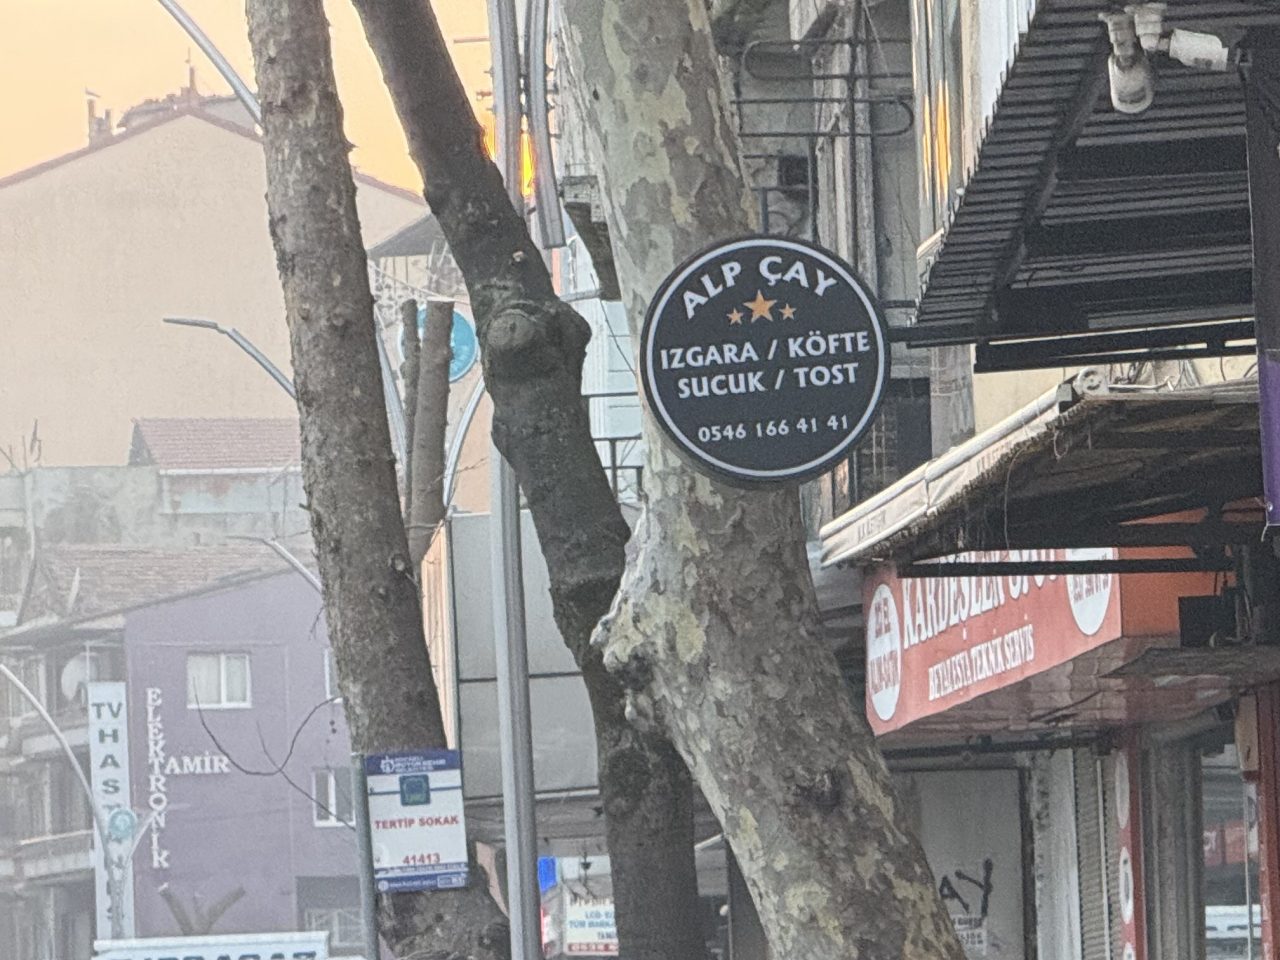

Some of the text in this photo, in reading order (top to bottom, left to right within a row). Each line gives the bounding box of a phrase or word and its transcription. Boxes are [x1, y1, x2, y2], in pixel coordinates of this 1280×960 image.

[682, 256, 838, 319] ALP ÇAY
[660, 341, 759, 370] IZGARA
[788, 330, 870, 358] KÖFTE
[678, 371, 768, 399] SUCUK
[793, 362, 859, 388] TOST
[698, 414, 848, 442] 0546 166 41 41
[91, 703, 122, 719] TV
[374, 815, 460, 830] TERTİP SOKAK
[402, 853, 440, 865] 41413
